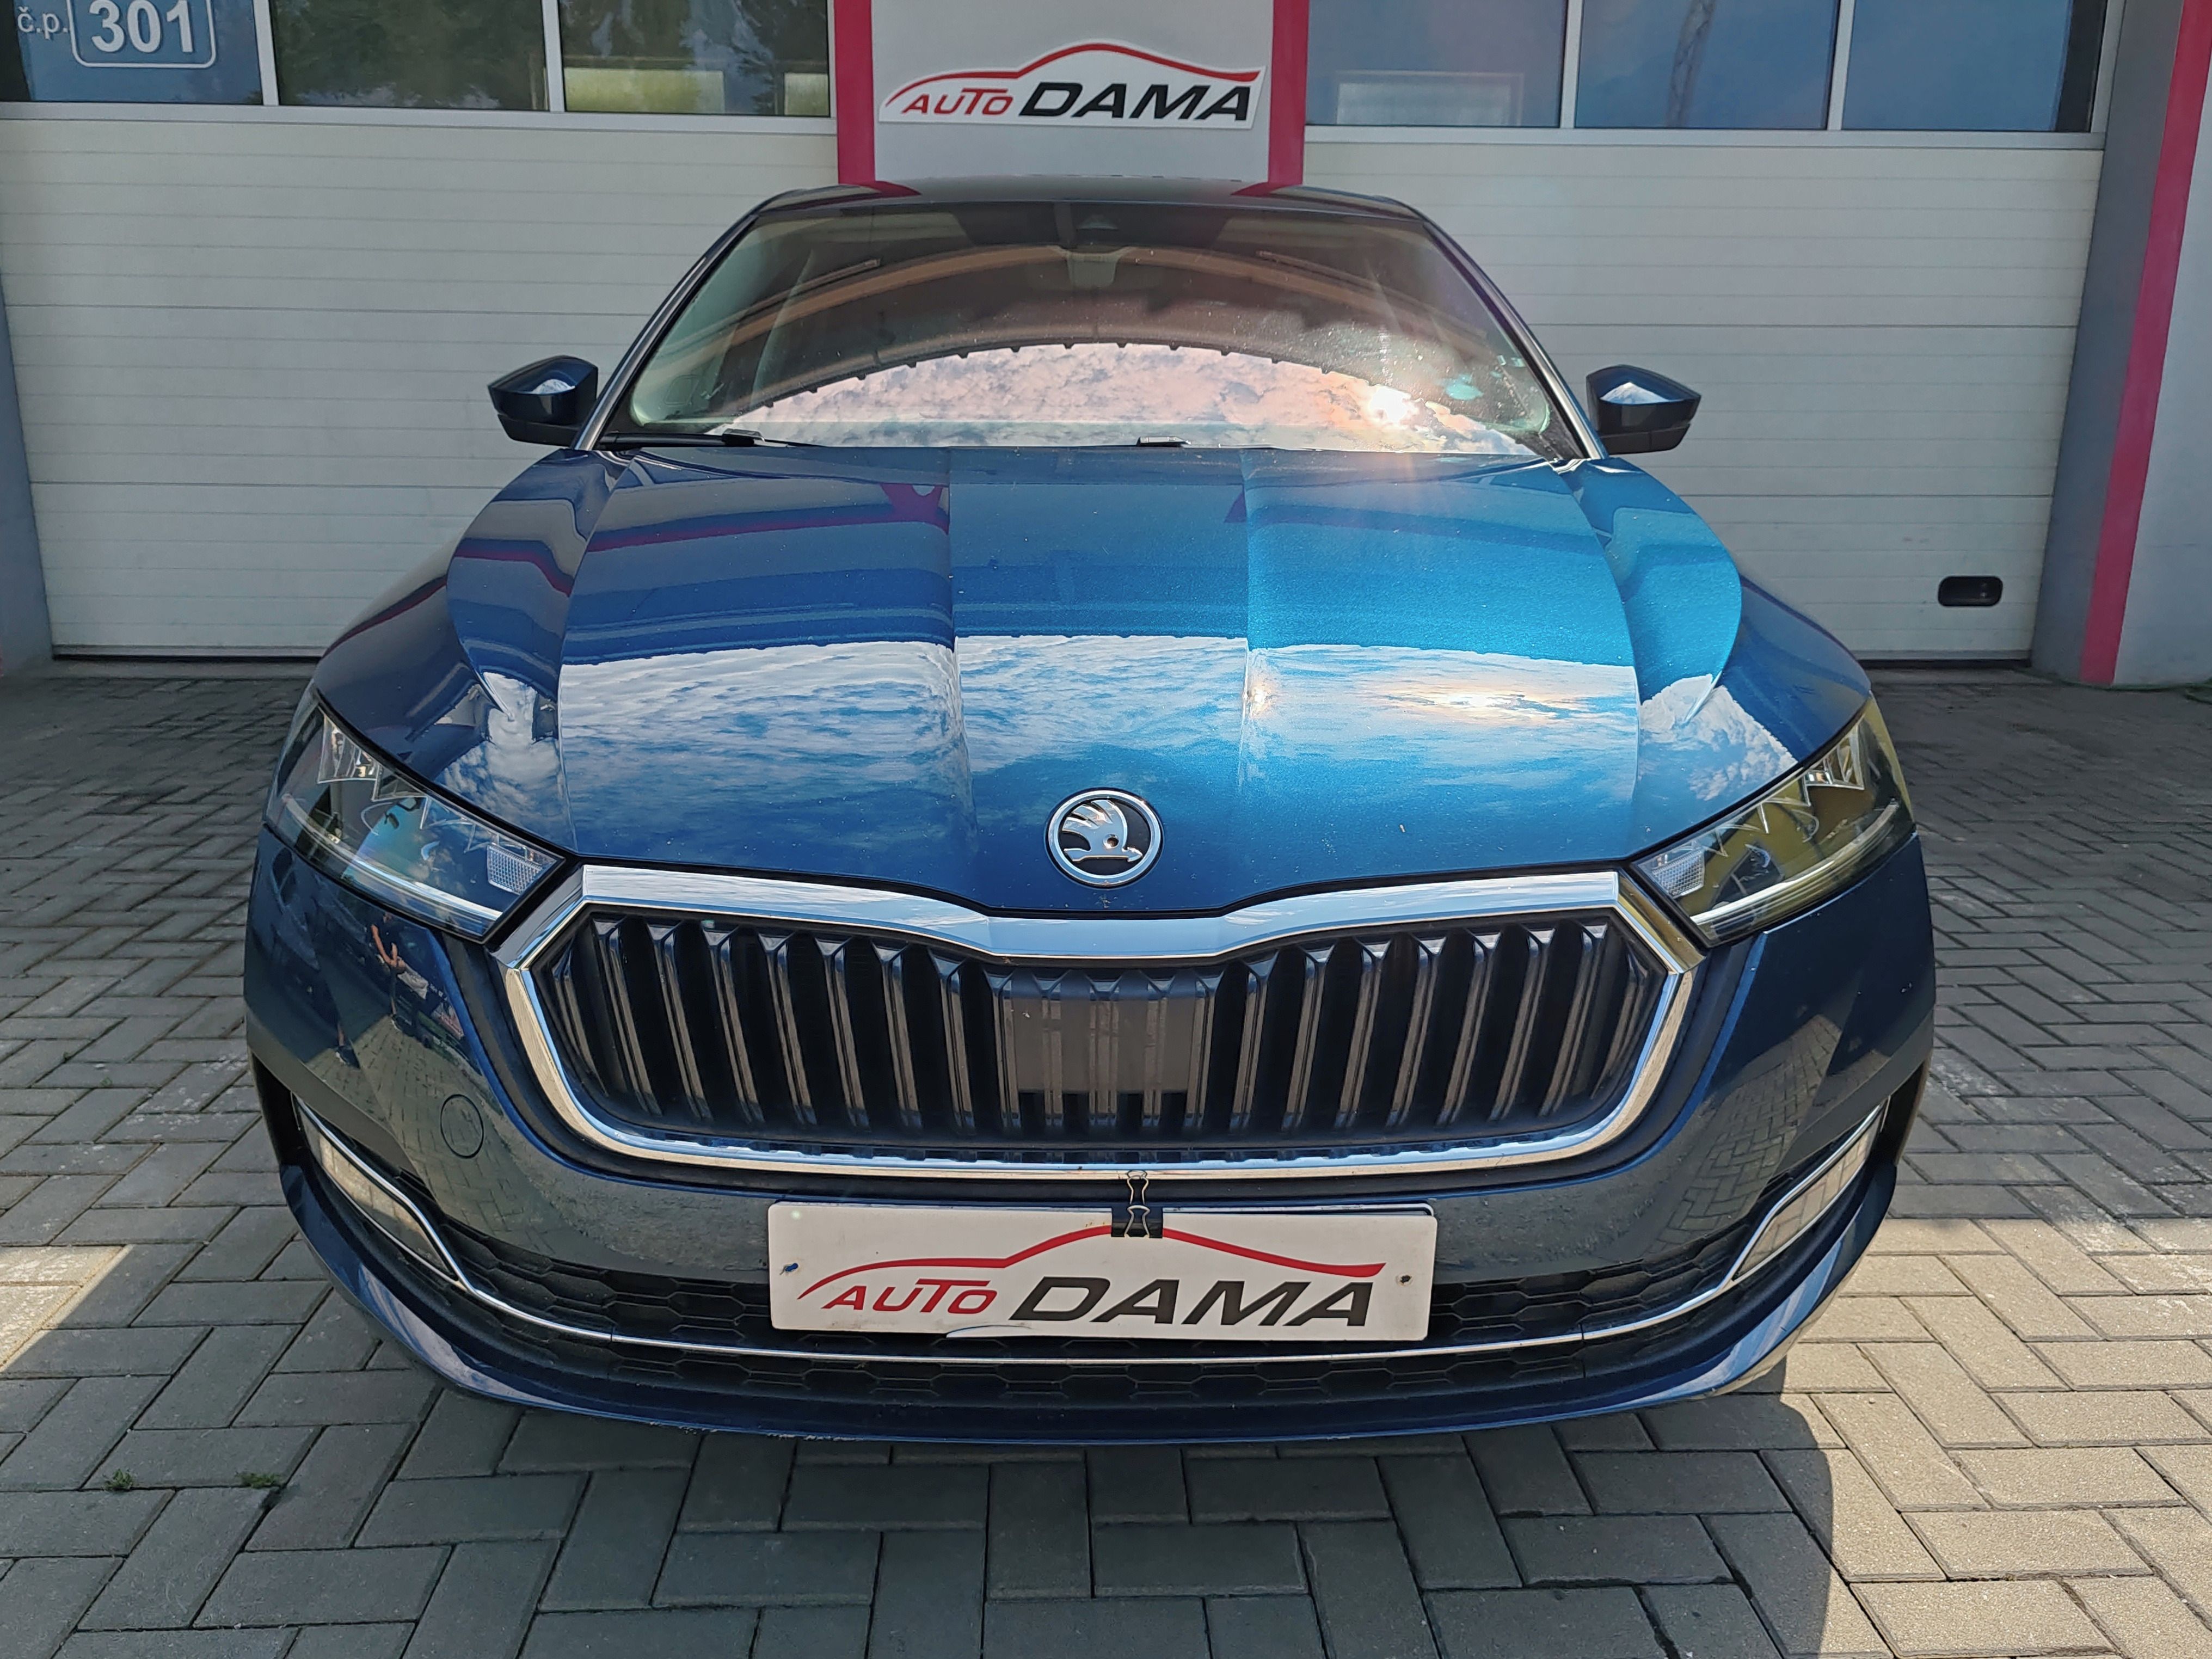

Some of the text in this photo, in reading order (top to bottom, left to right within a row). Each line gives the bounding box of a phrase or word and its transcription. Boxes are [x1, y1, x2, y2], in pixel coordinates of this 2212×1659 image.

[17, 0, 194, 53] č.p. 301
[901, 82, 1251, 121] AUTO DAMA
[822, 1276, 1374, 1327] AUTO DAMA
